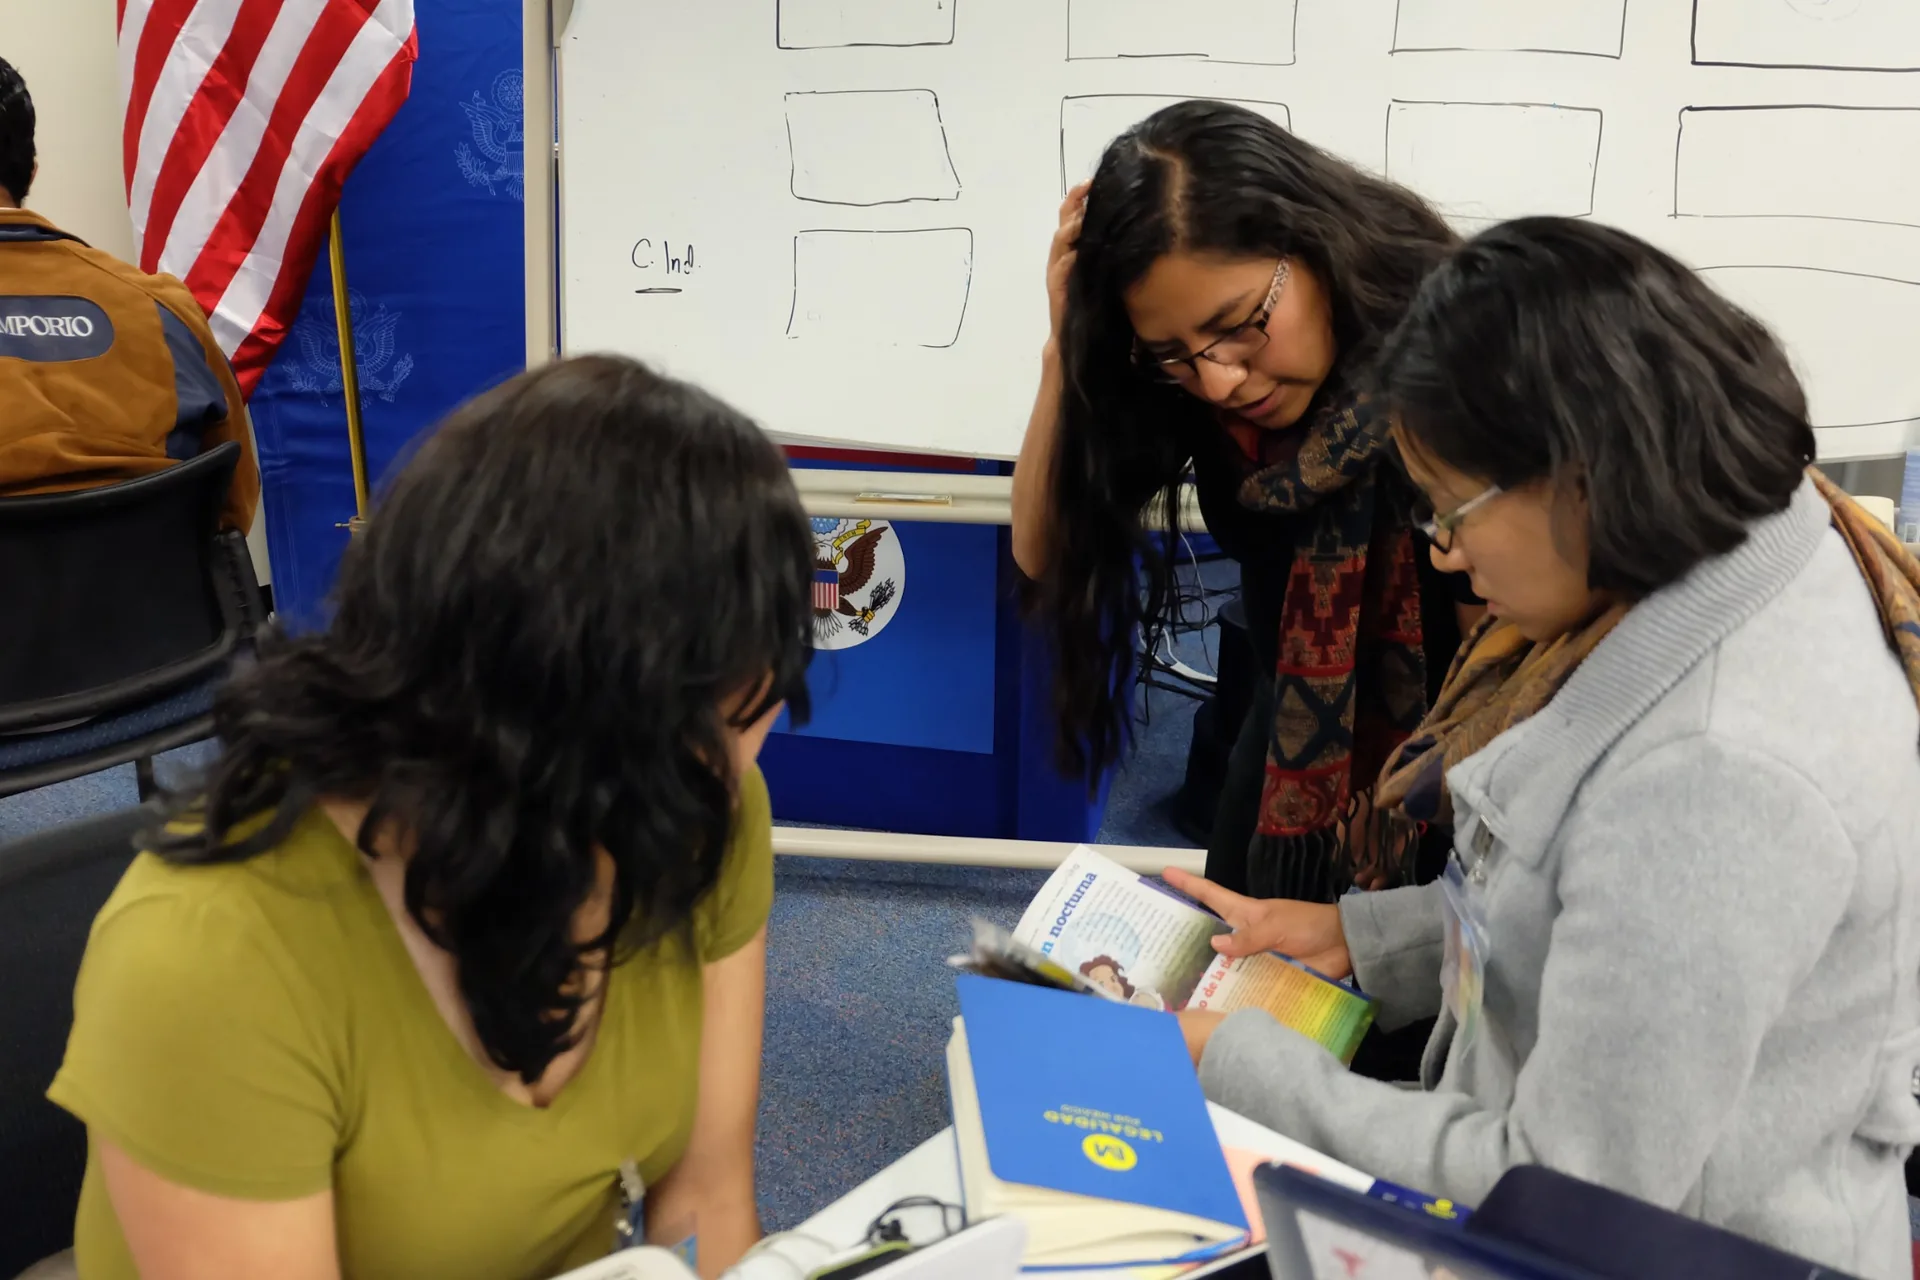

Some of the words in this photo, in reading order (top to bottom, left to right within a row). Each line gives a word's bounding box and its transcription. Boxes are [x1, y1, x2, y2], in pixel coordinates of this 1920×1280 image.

[631, 238, 655, 269] C.
[1049, 871, 1098, 939] nocturna
[1203, 982, 1218, 999] de
[1211, 970, 1226, 982] la
[1043, 1109, 1164, 1144] LEGALIDAD
